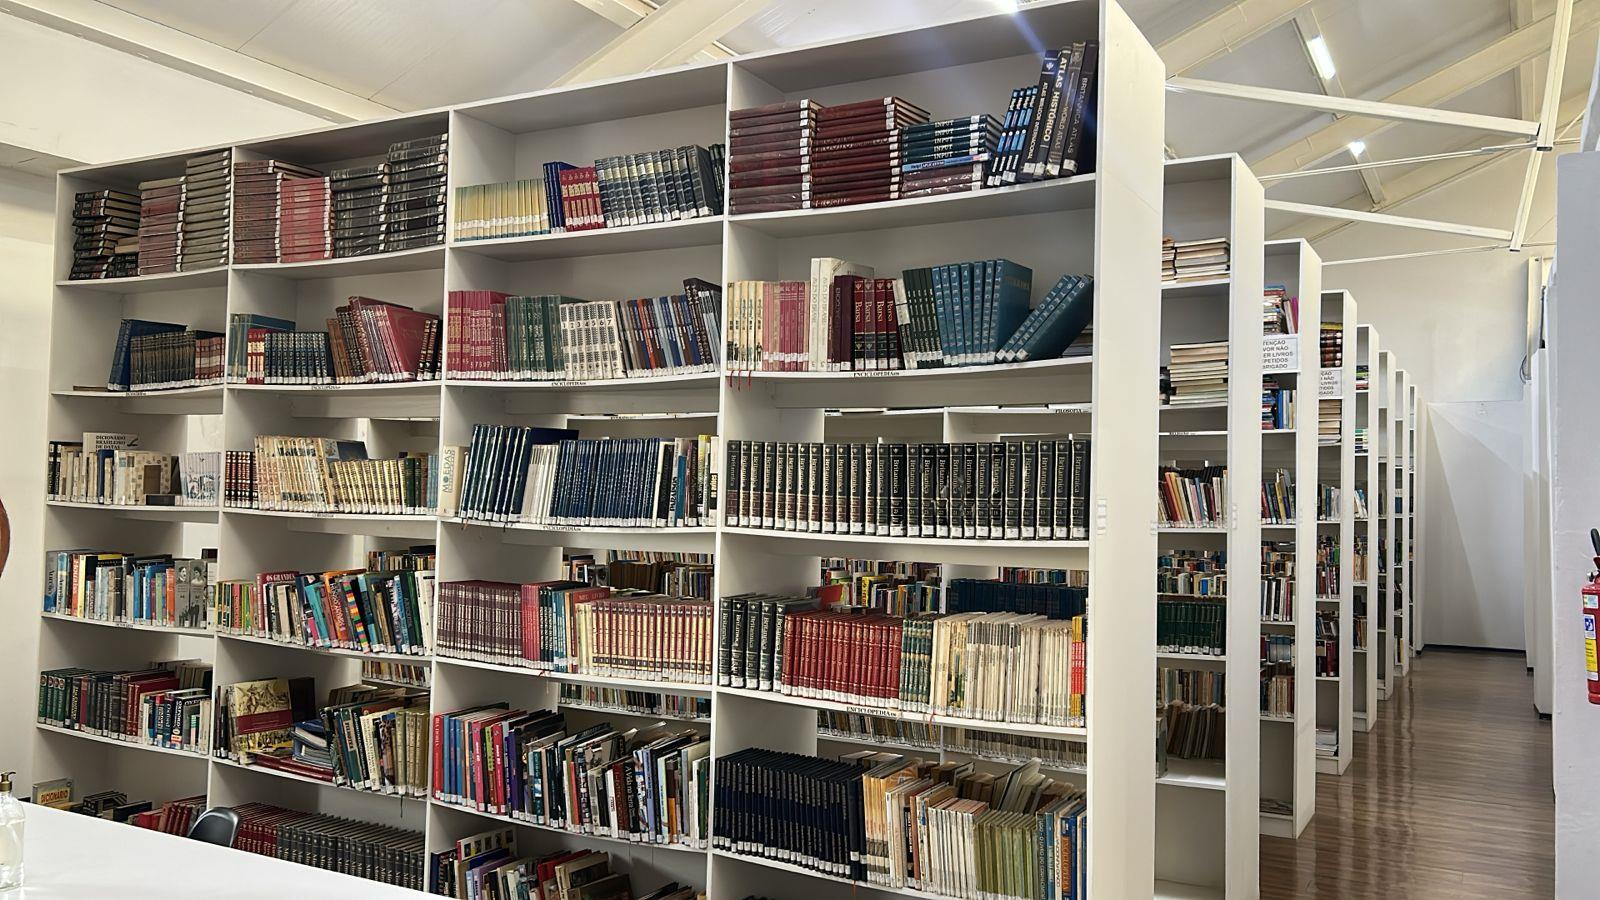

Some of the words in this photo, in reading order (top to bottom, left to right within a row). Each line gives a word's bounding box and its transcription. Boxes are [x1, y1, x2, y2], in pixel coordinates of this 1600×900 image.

[1056, 58, 1068, 88] ATLAS
[935, 120, 954, 128] INPUT
[1043, 91, 1060, 141] HISTÓRICO
[935, 128, 954, 136] INPUT
[1068, 127, 1077, 153] ATLAS
[876, 301, 884, 322] Barsa
[442, 449, 451, 492] MOEDAS
[1008, 458, 1017, 494] Britannica
[1040, 457, 1049, 495] Britannica
[41, 789, 68, 802] DICIONÁRIO
